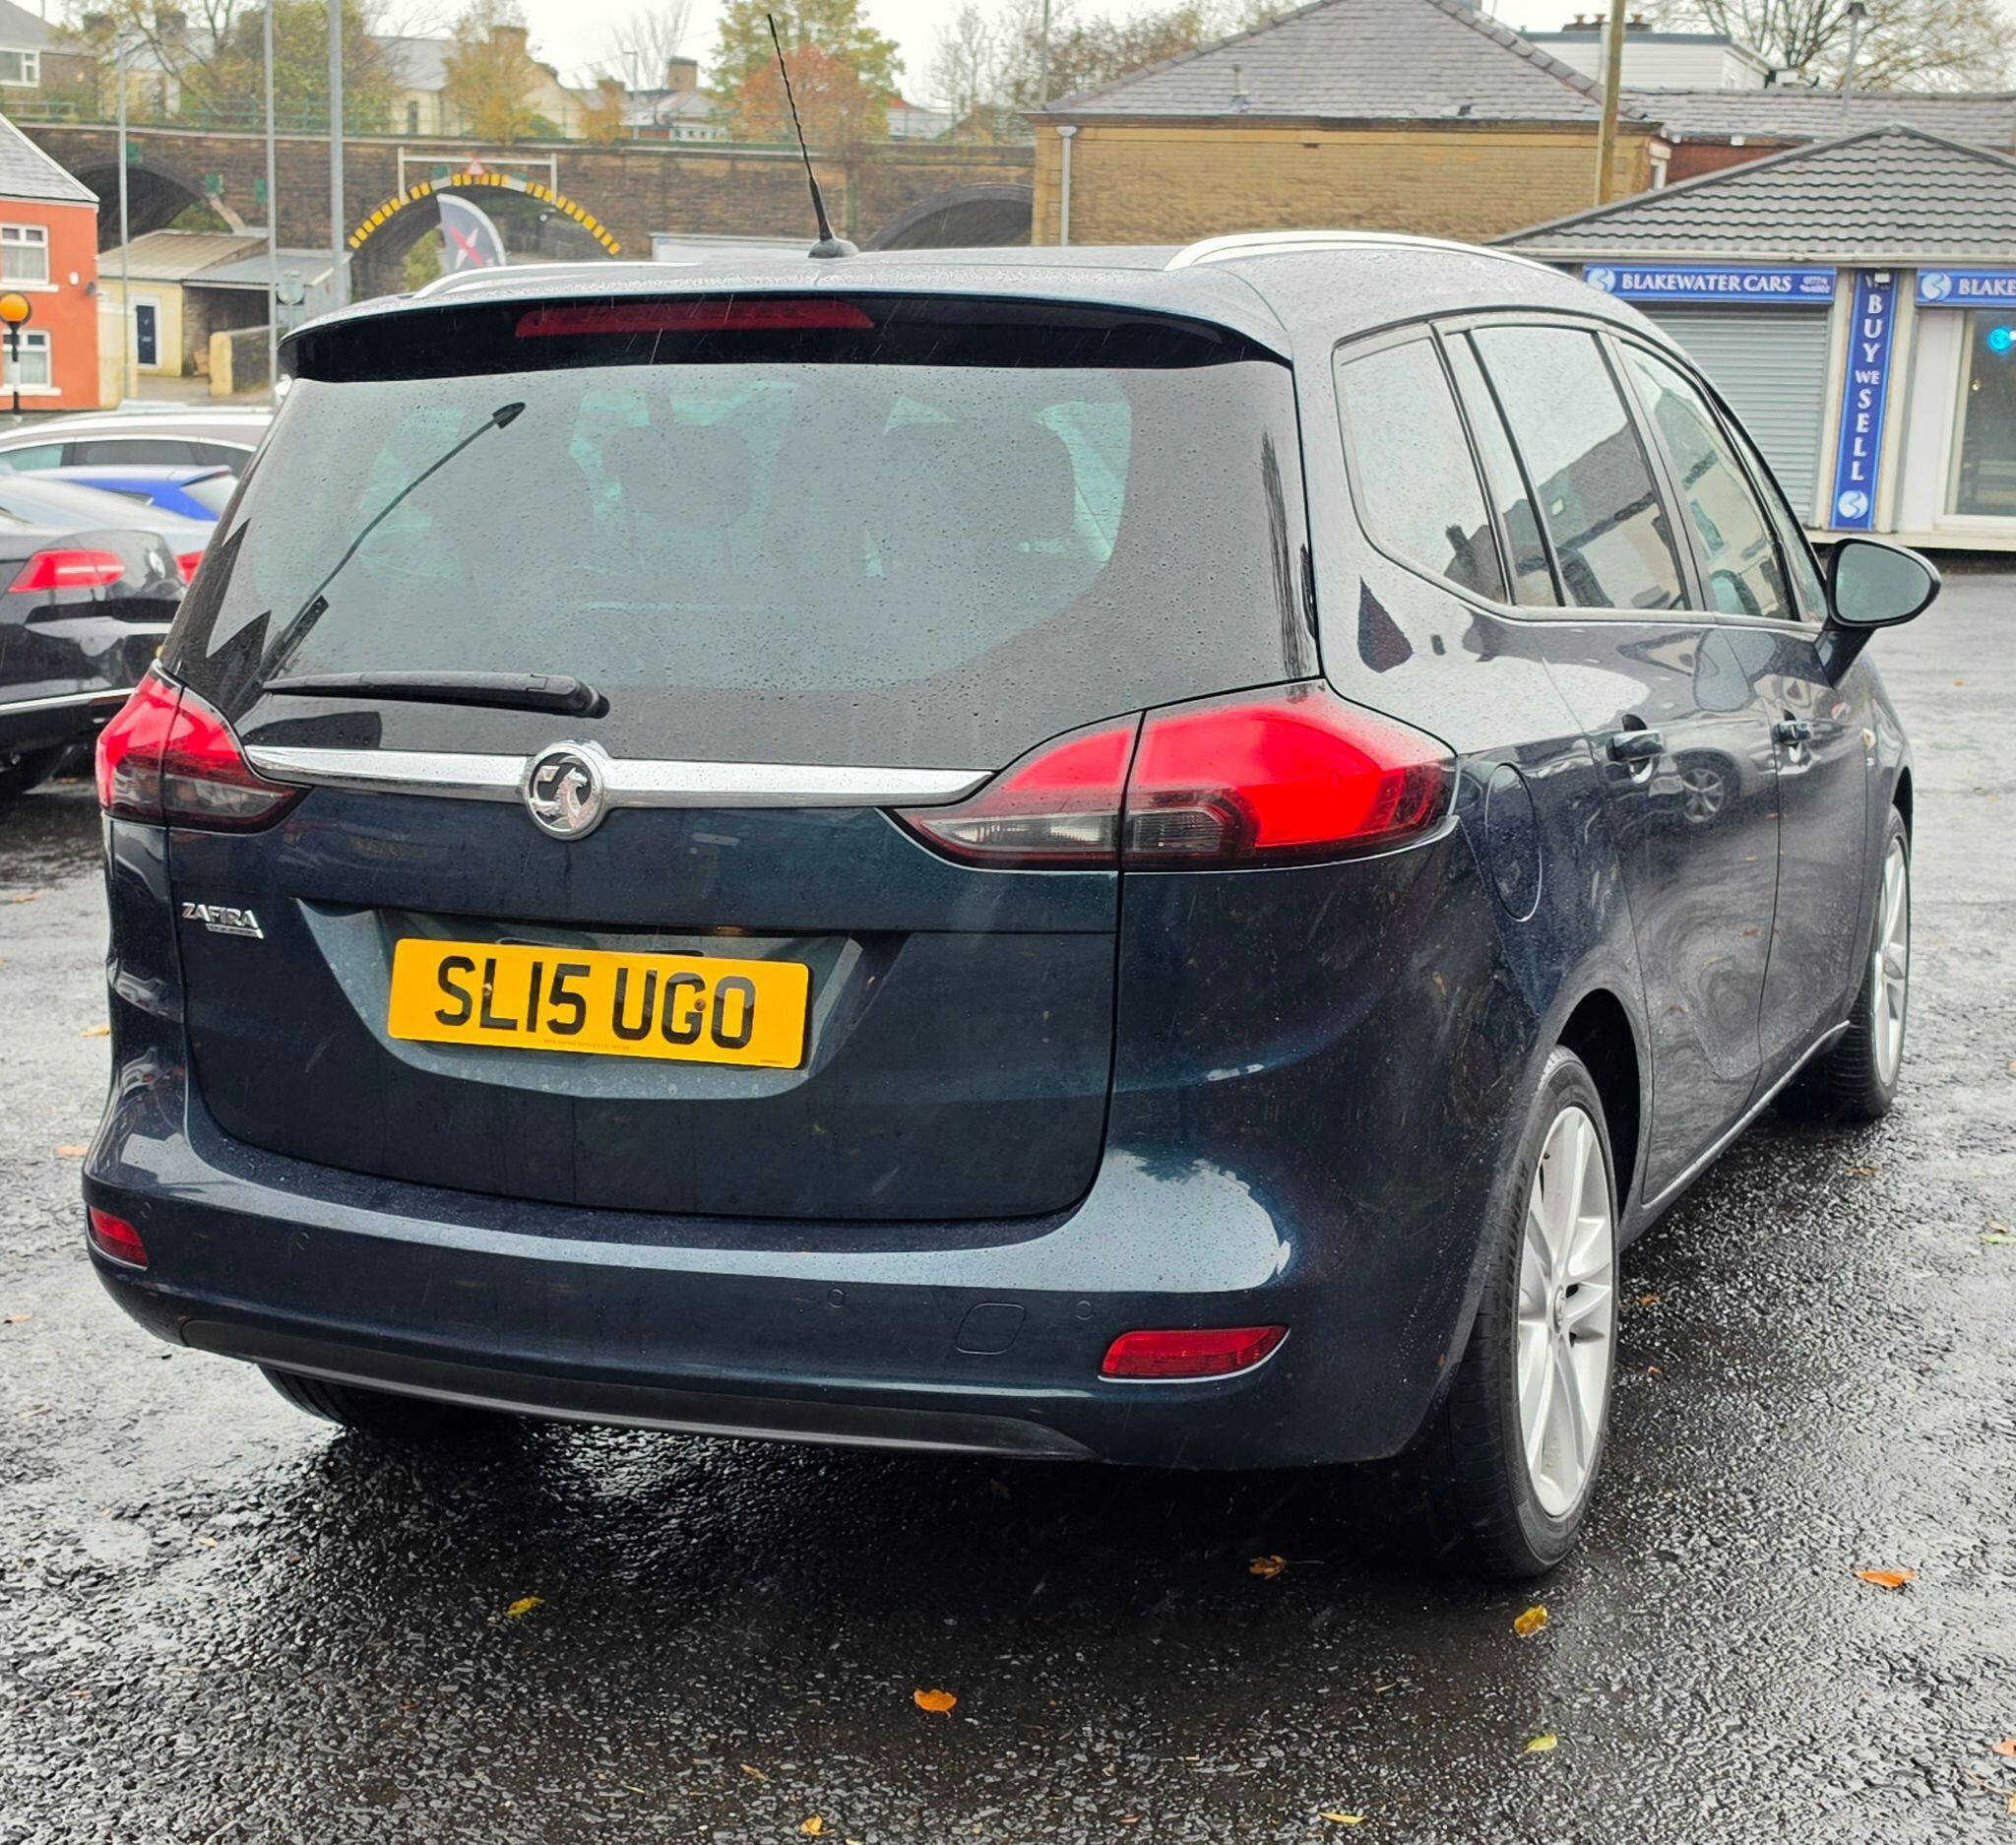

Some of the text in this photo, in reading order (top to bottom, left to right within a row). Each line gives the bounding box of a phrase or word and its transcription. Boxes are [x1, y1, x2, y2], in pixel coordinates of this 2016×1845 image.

[1621, 273, 1741, 291] BLAKEWATER
[1743, 275, 1793, 292] CARS
[1958, 278, 2016, 296] BLAKE
[1862, 293, 1883, 363] BUY
[1855, 369, 1881, 385] WE
[1851, 388, 1872, 481] SELL
[181, 902, 259, 928] ZAFIRA
[434, 954, 757, 1050] SL15 UGO
